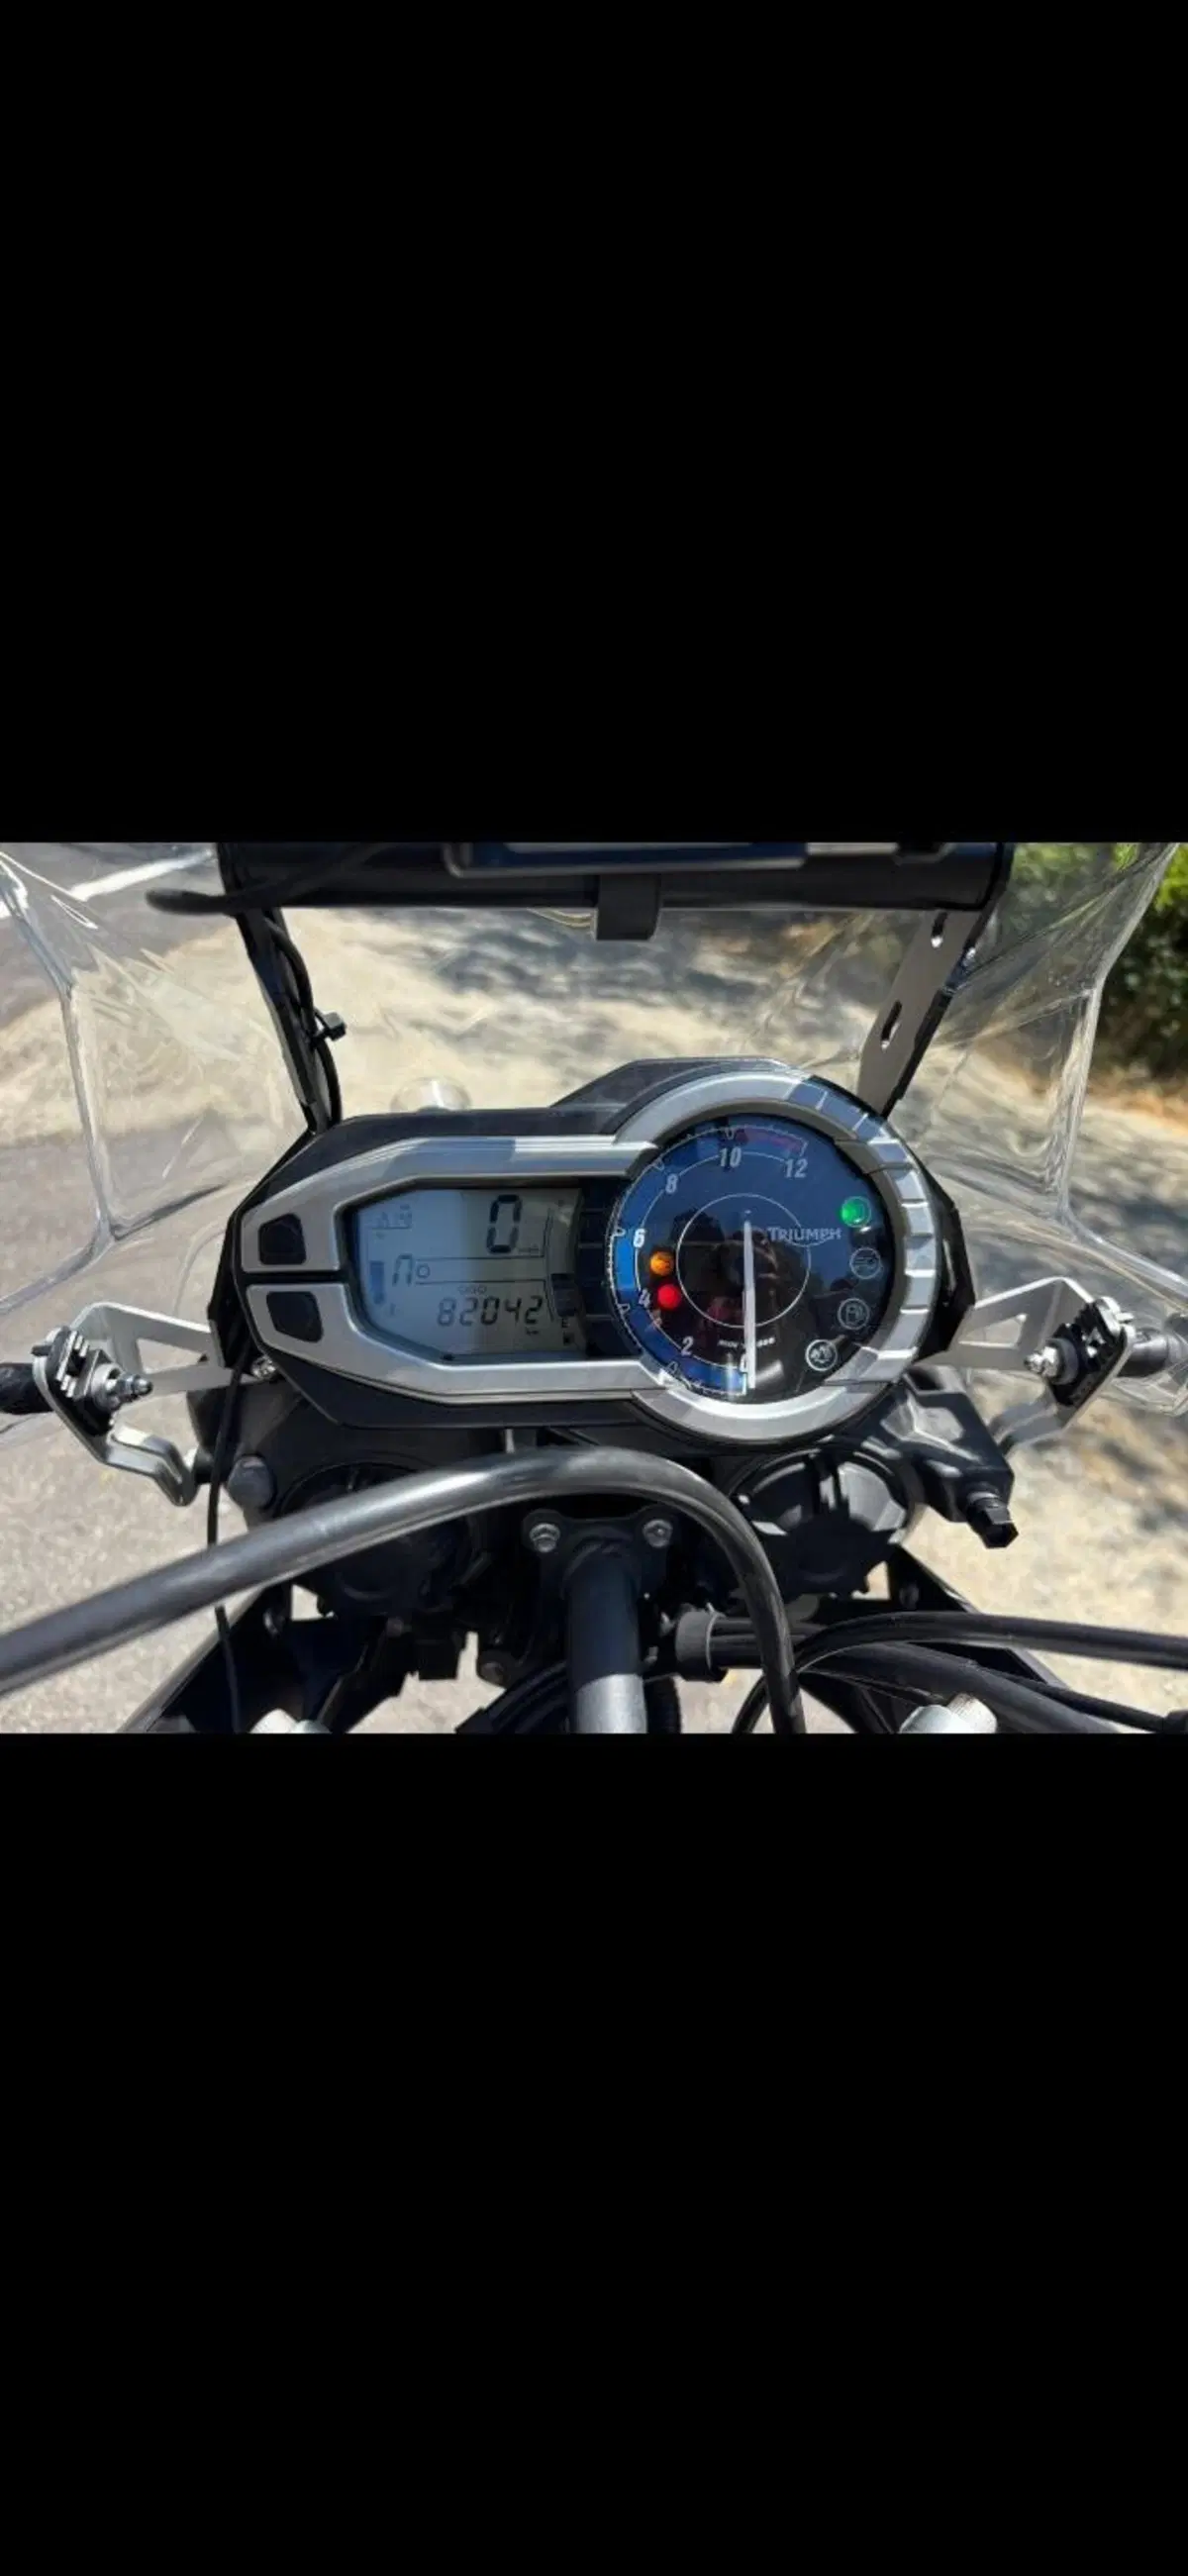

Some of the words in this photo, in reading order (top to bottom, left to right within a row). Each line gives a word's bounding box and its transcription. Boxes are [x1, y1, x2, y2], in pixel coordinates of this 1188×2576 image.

[720, 1147, 742, 1167] 10
[784, 1158, 808, 1178] 12
[664, 1174, 678, 1194] 8
[487, 1194, 522, 1253] 0
[633, 1229, 645, 1248] 6
[767, 1227, 842, 1245] TRIUMPH
[639, 1289, 650, 1308] 4
[438, 1296, 544, 1327] 82042
[681, 1337, 693, 1355] 2
